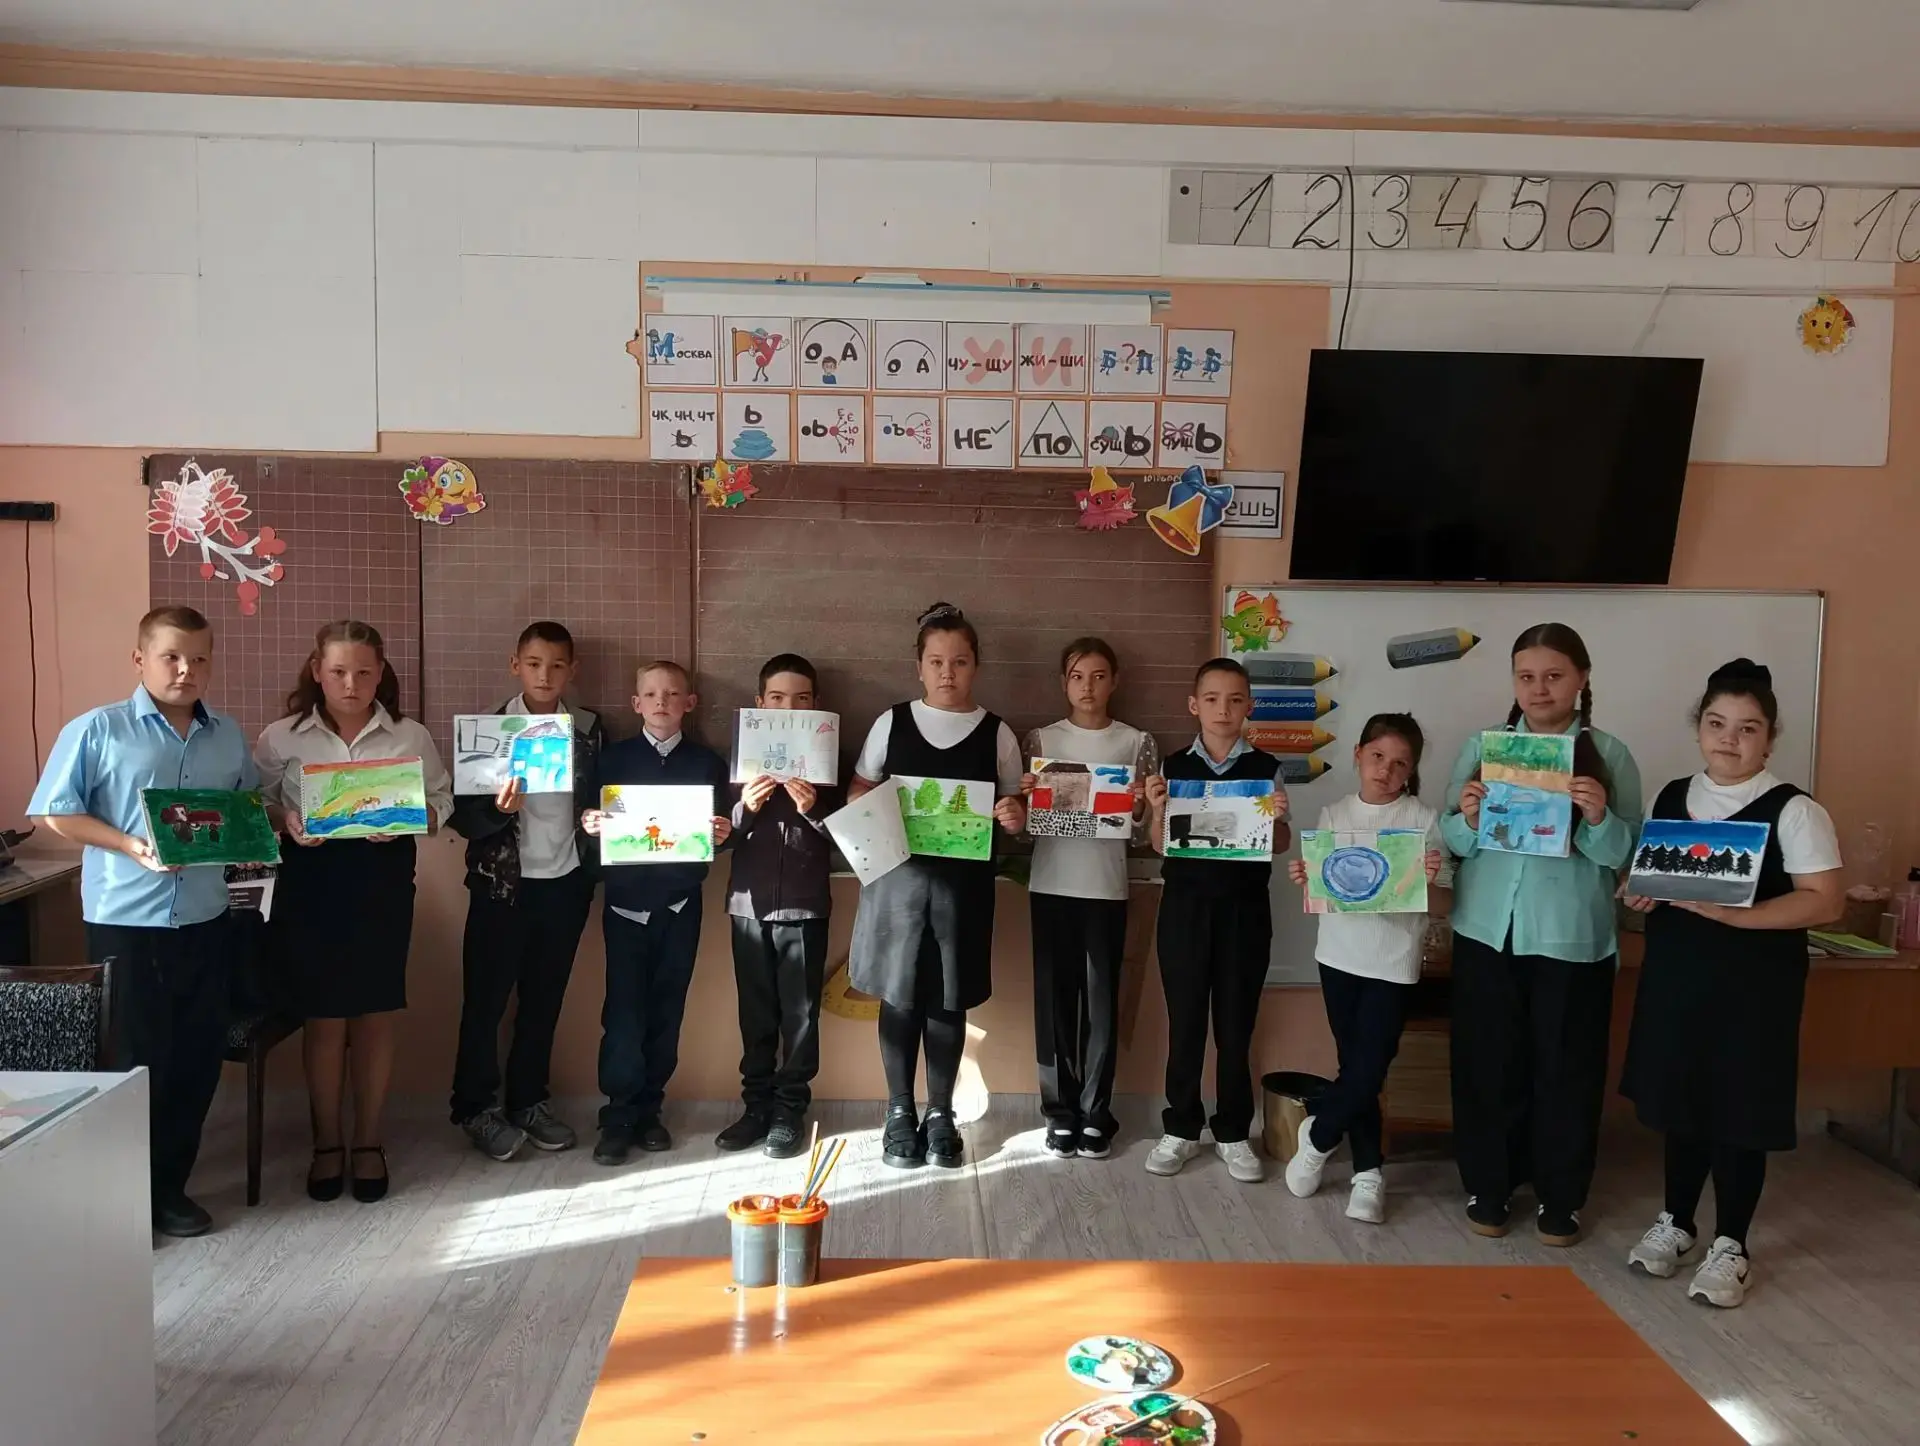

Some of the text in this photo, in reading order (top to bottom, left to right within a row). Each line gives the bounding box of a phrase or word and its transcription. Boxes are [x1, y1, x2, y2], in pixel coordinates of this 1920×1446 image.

[1233, 174, 1273, 245] 1
[1292, 174, 1343, 249] 2
[1367, 174, 1411, 248] 3
[1434, 176, 1478, 248] 4
[1503, 176, 1551, 251] 5
[1567, 181, 1615, 250] 6
[1649, 183, 1685, 254] 7
[1708, 182, 1755, 256] 8
[1774, 185, 1825, 259] 9
[698, 411, 715, 421] ЧТ
[954, 428, 992, 450] НЕ
[1033, 433, 1072, 455] ПО
